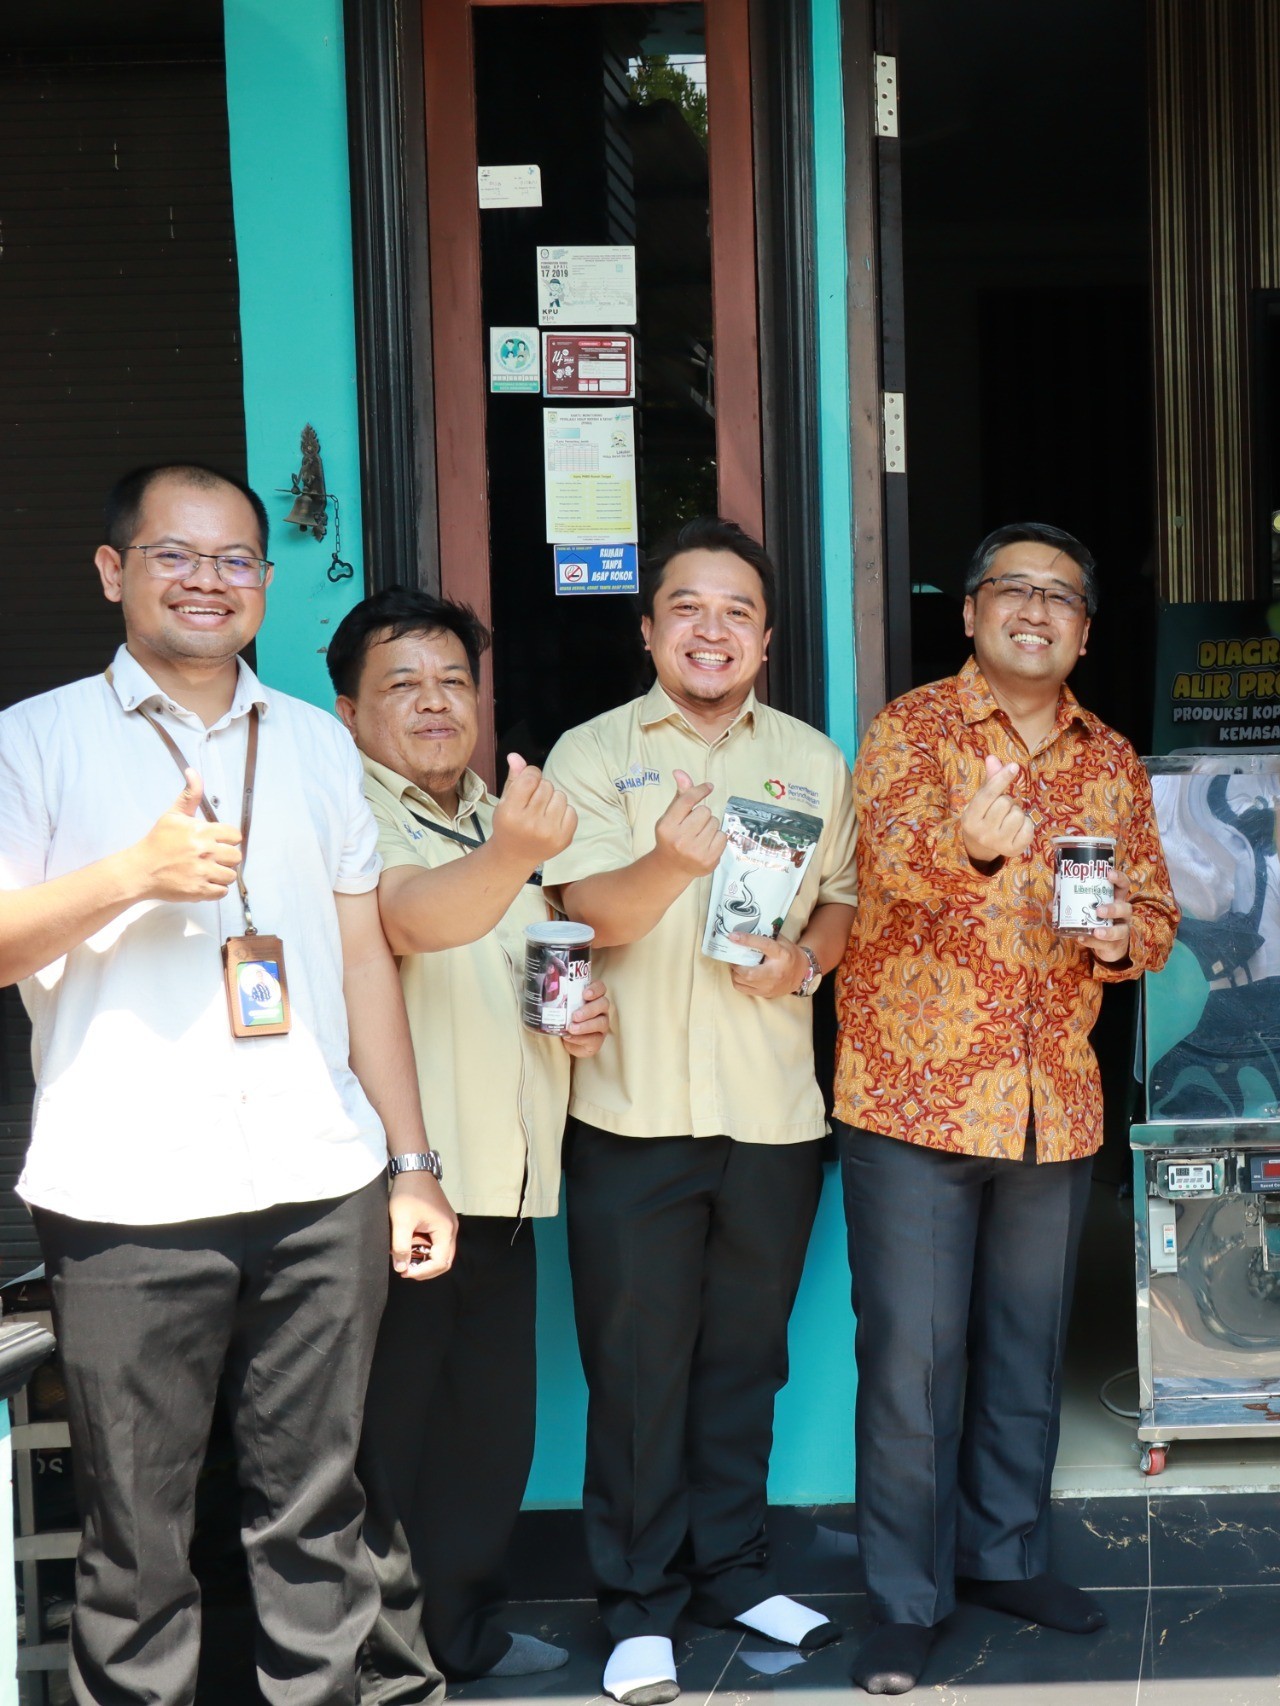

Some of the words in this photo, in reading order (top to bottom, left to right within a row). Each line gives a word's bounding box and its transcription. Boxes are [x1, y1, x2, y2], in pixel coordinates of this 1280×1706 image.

[541, 269, 550, 278] 17
[552, 269, 569, 278] 2019
[599, 547, 625, 558] RUMAH
[602, 560, 623, 570] TANPA
[591, 571, 609, 581] ASAP
[610, 571, 633, 580] ROKOK
[1172, 673, 1232, 699] ALIR
[1173, 706, 1247, 722] PRODUKSI
[1062, 860, 1094, 881] Kopi
